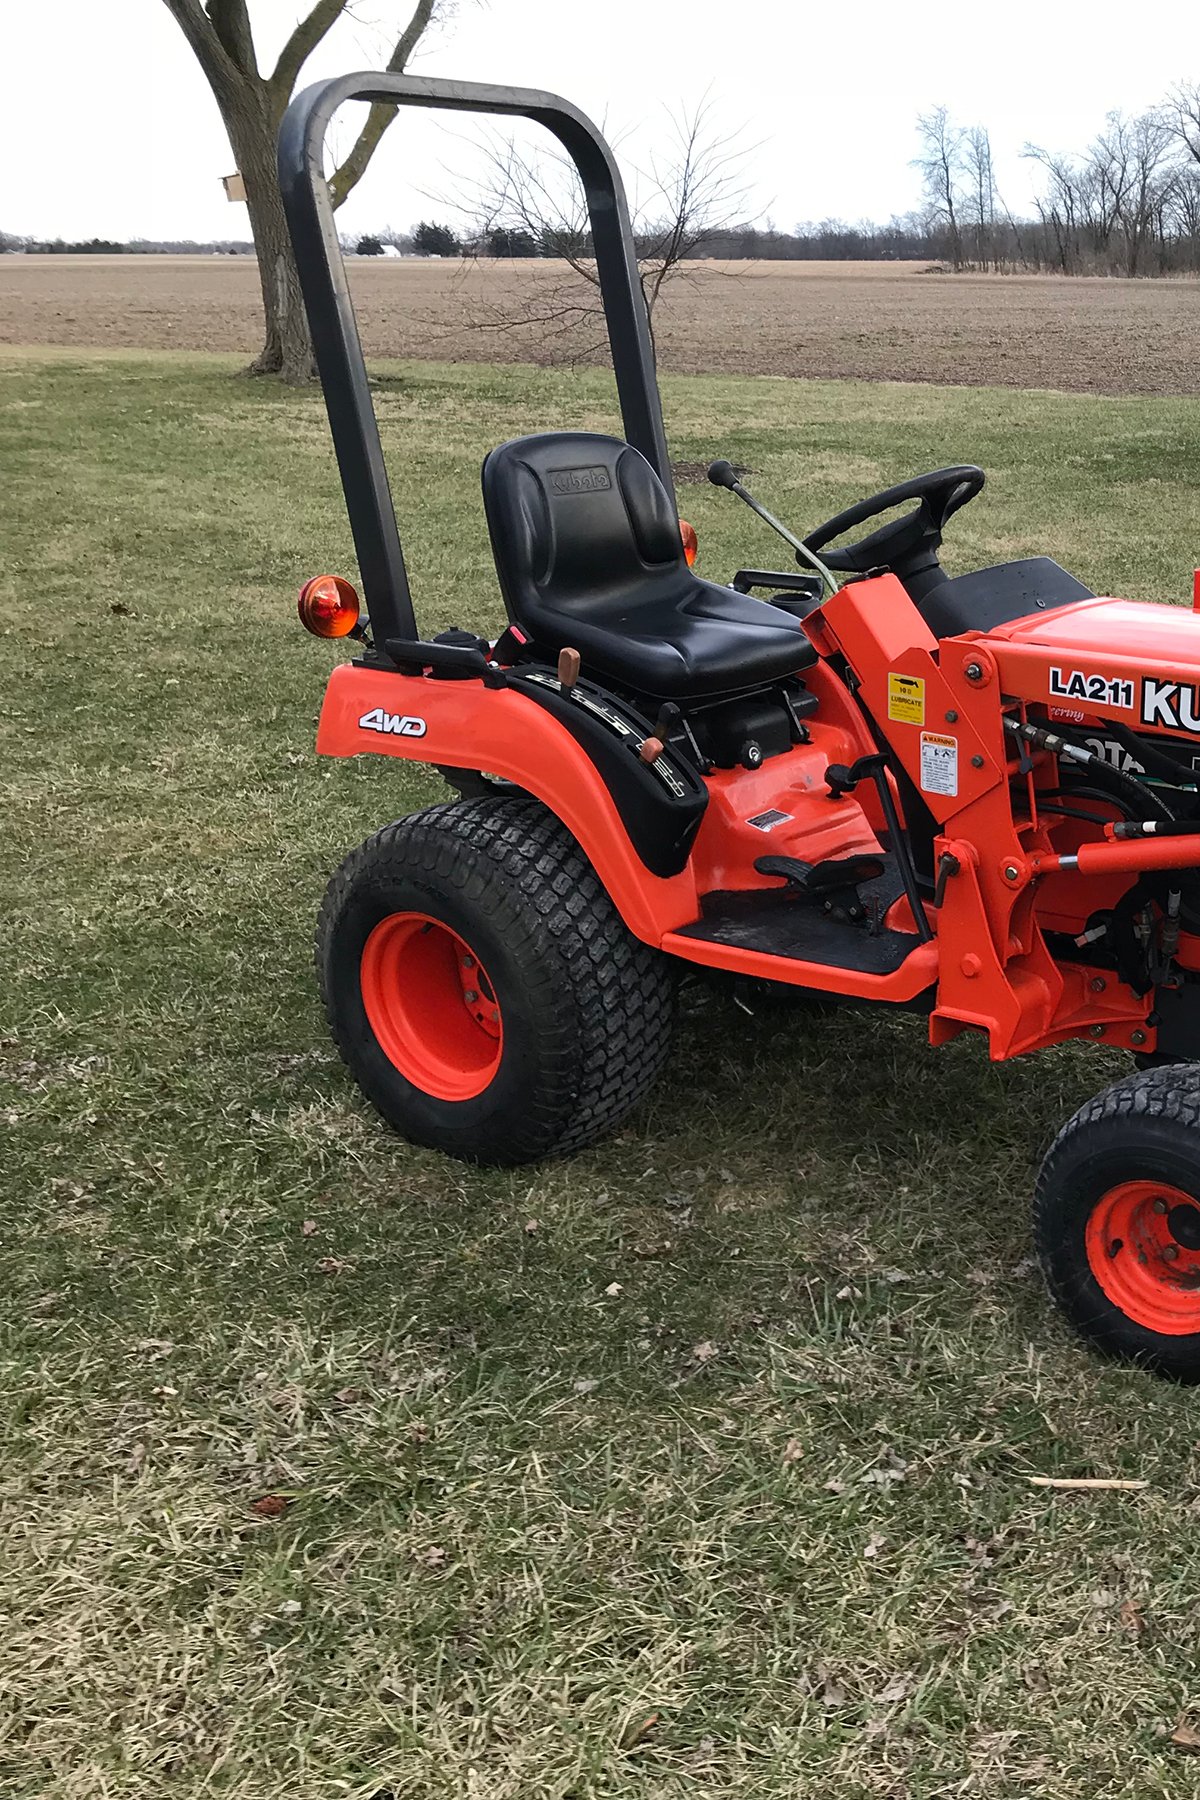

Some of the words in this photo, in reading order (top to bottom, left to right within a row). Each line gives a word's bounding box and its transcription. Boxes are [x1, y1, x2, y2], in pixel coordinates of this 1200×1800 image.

[1049, 667, 1134, 709] LA211
[891, 695, 922, 708] LUBRICATE
[359, 708, 427, 738] 4WD
[928, 736, 955, 747] WARNING
